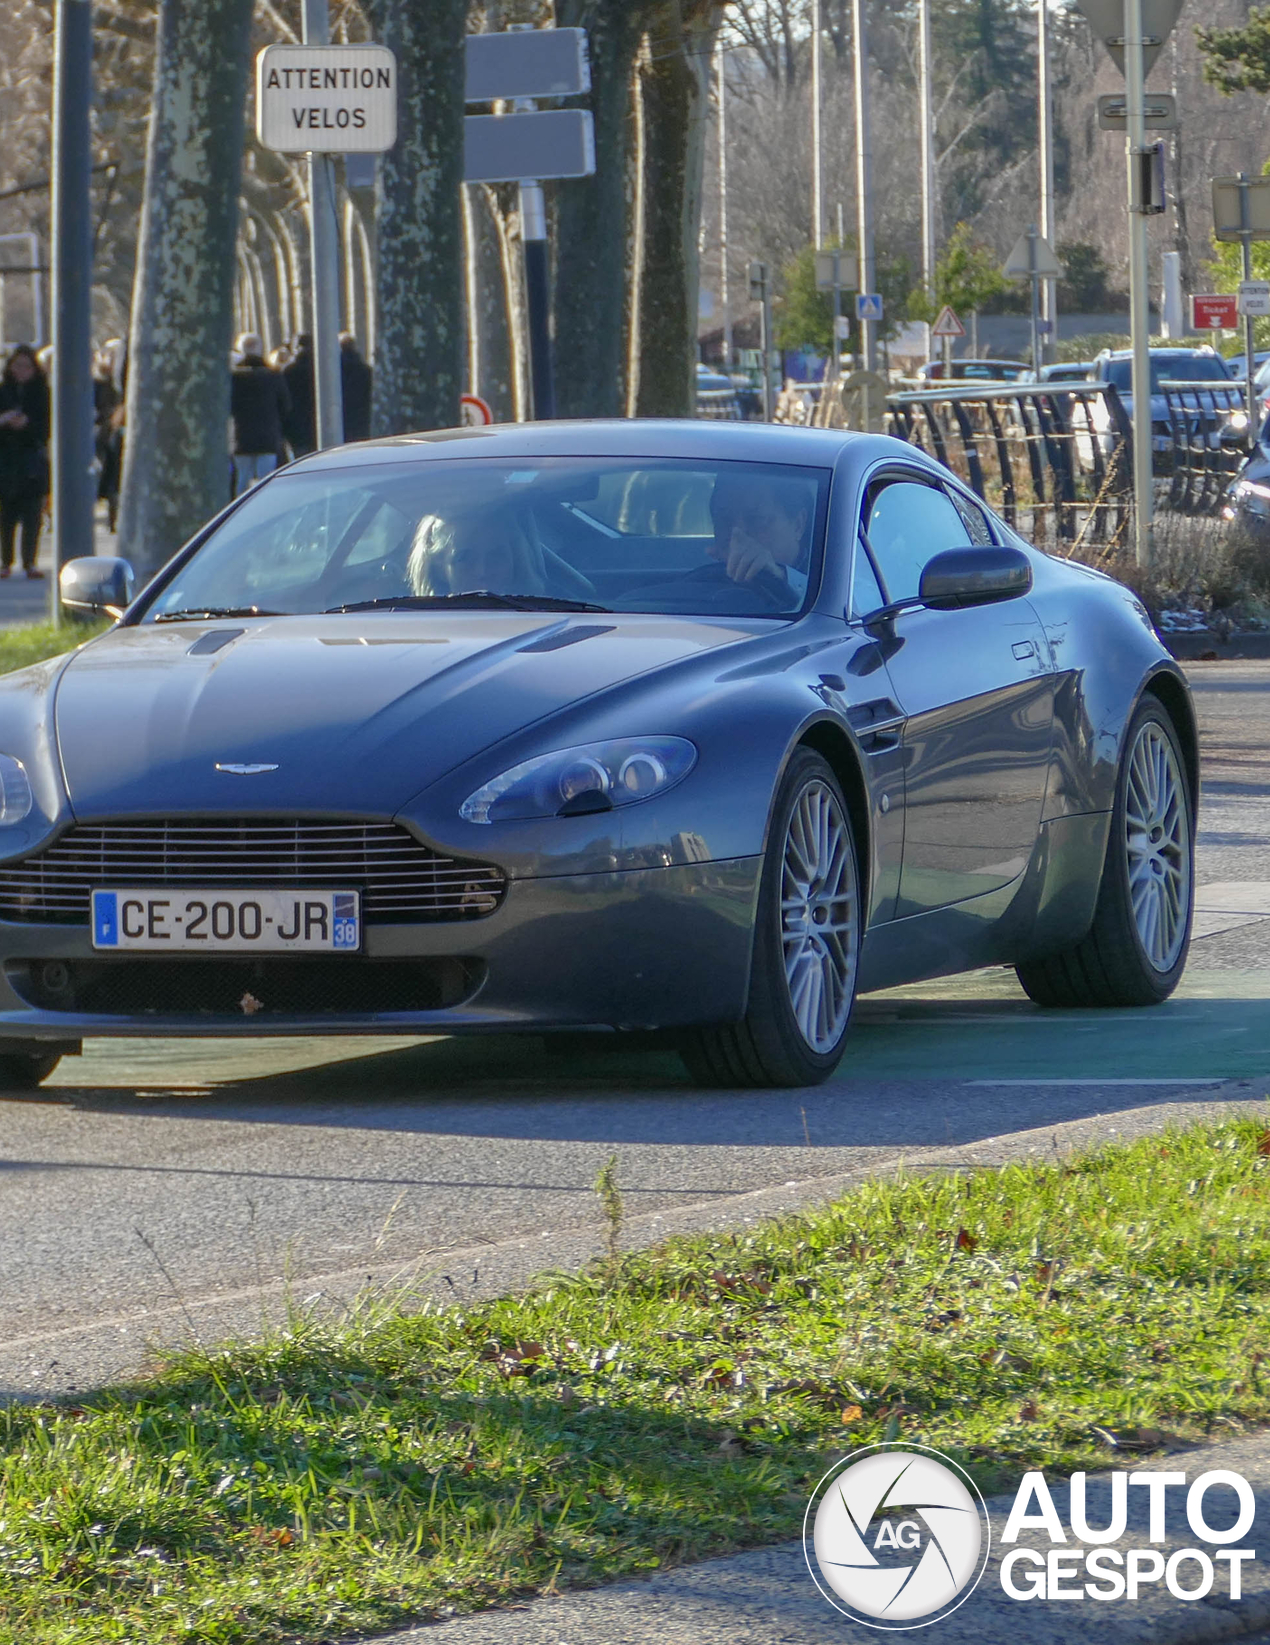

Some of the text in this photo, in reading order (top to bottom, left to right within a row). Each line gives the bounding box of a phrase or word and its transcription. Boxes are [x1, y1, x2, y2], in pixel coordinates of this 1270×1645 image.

[266, 67, 391, 89] ATTENTION
[292, 107, 366, 129] VELOS
[102, 900, 355, 943] F CE-200-JR 38
